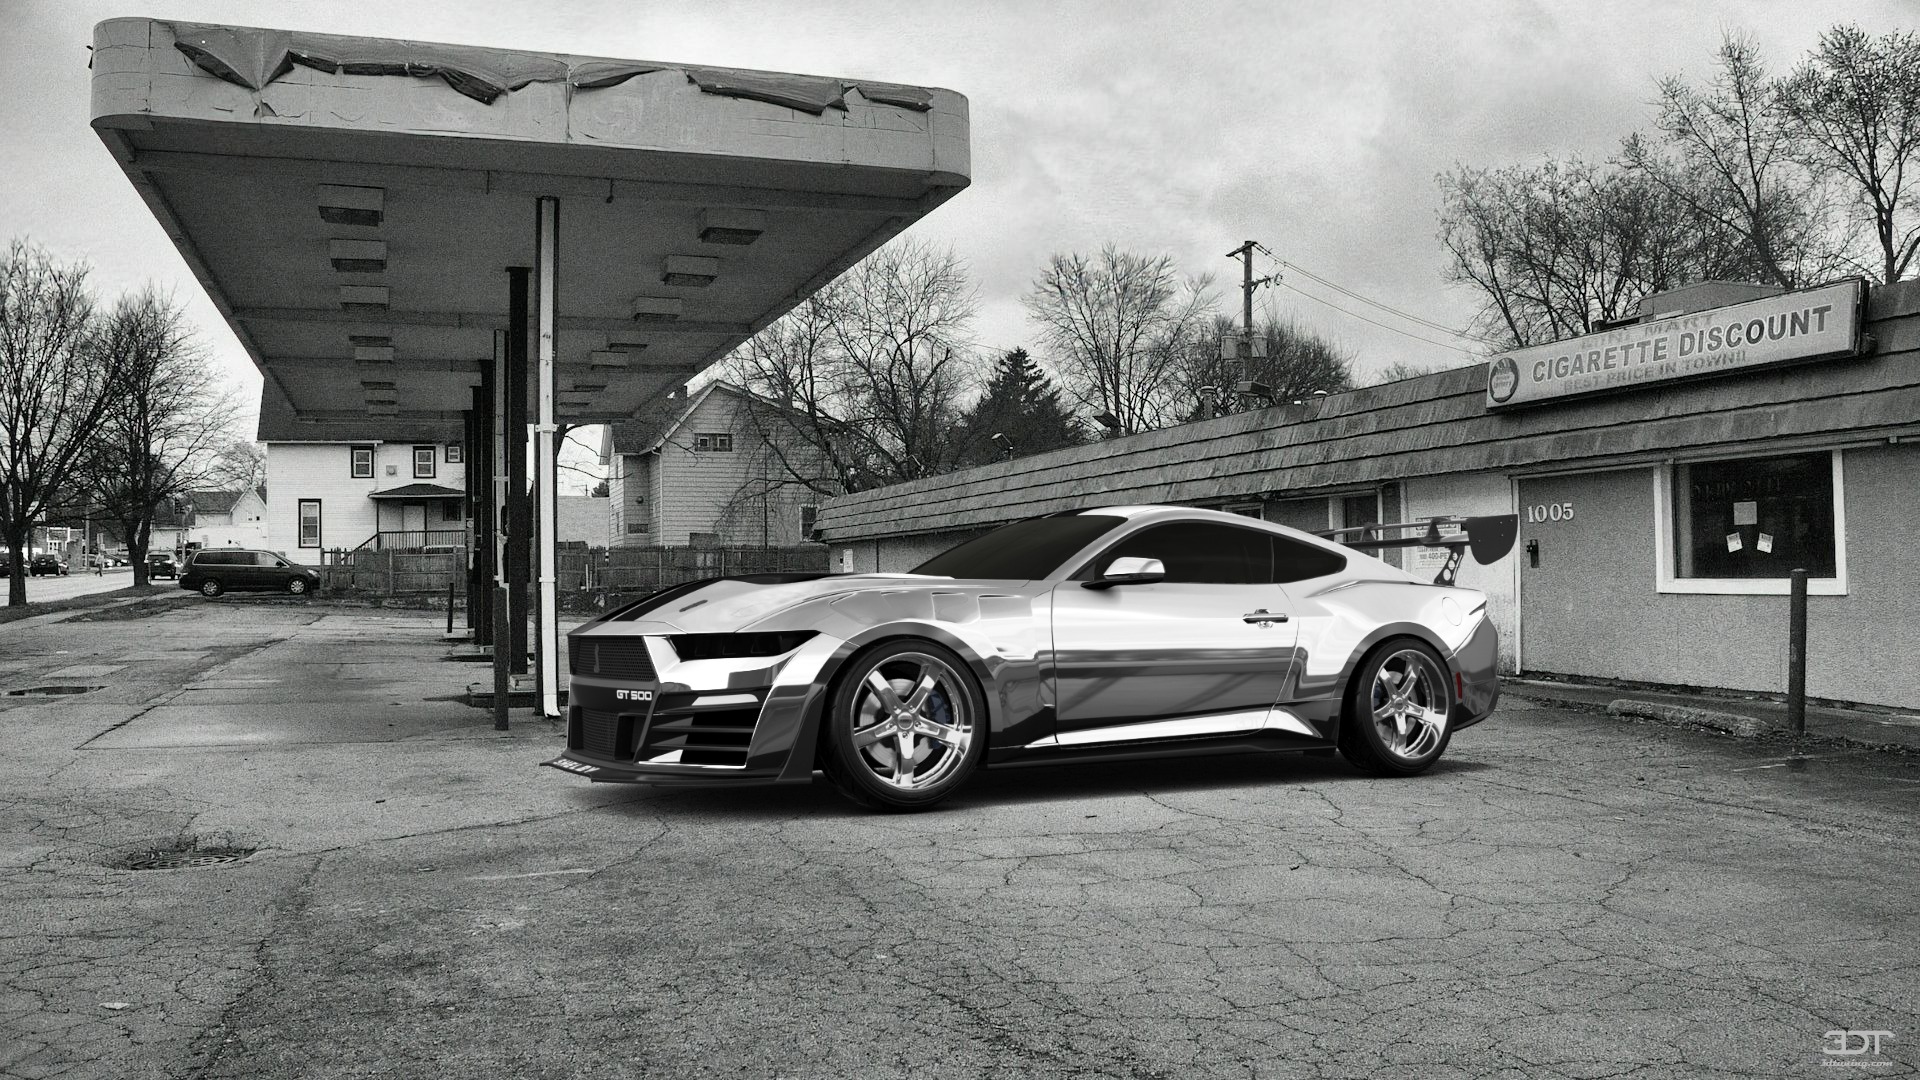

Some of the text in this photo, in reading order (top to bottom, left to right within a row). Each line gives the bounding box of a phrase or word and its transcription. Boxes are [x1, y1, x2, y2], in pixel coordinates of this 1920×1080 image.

[1532, 304, 1832, 383] CIGARETTE DISCOUNT
[1565, 376, 1600, 393] BEST
[1606, 366, 1653, 386] PRICE
[1660, 362, 1677, 375] IN
[1527, 502, 1574, 523] 1005
[616, 689, 653, 701] GT 500
